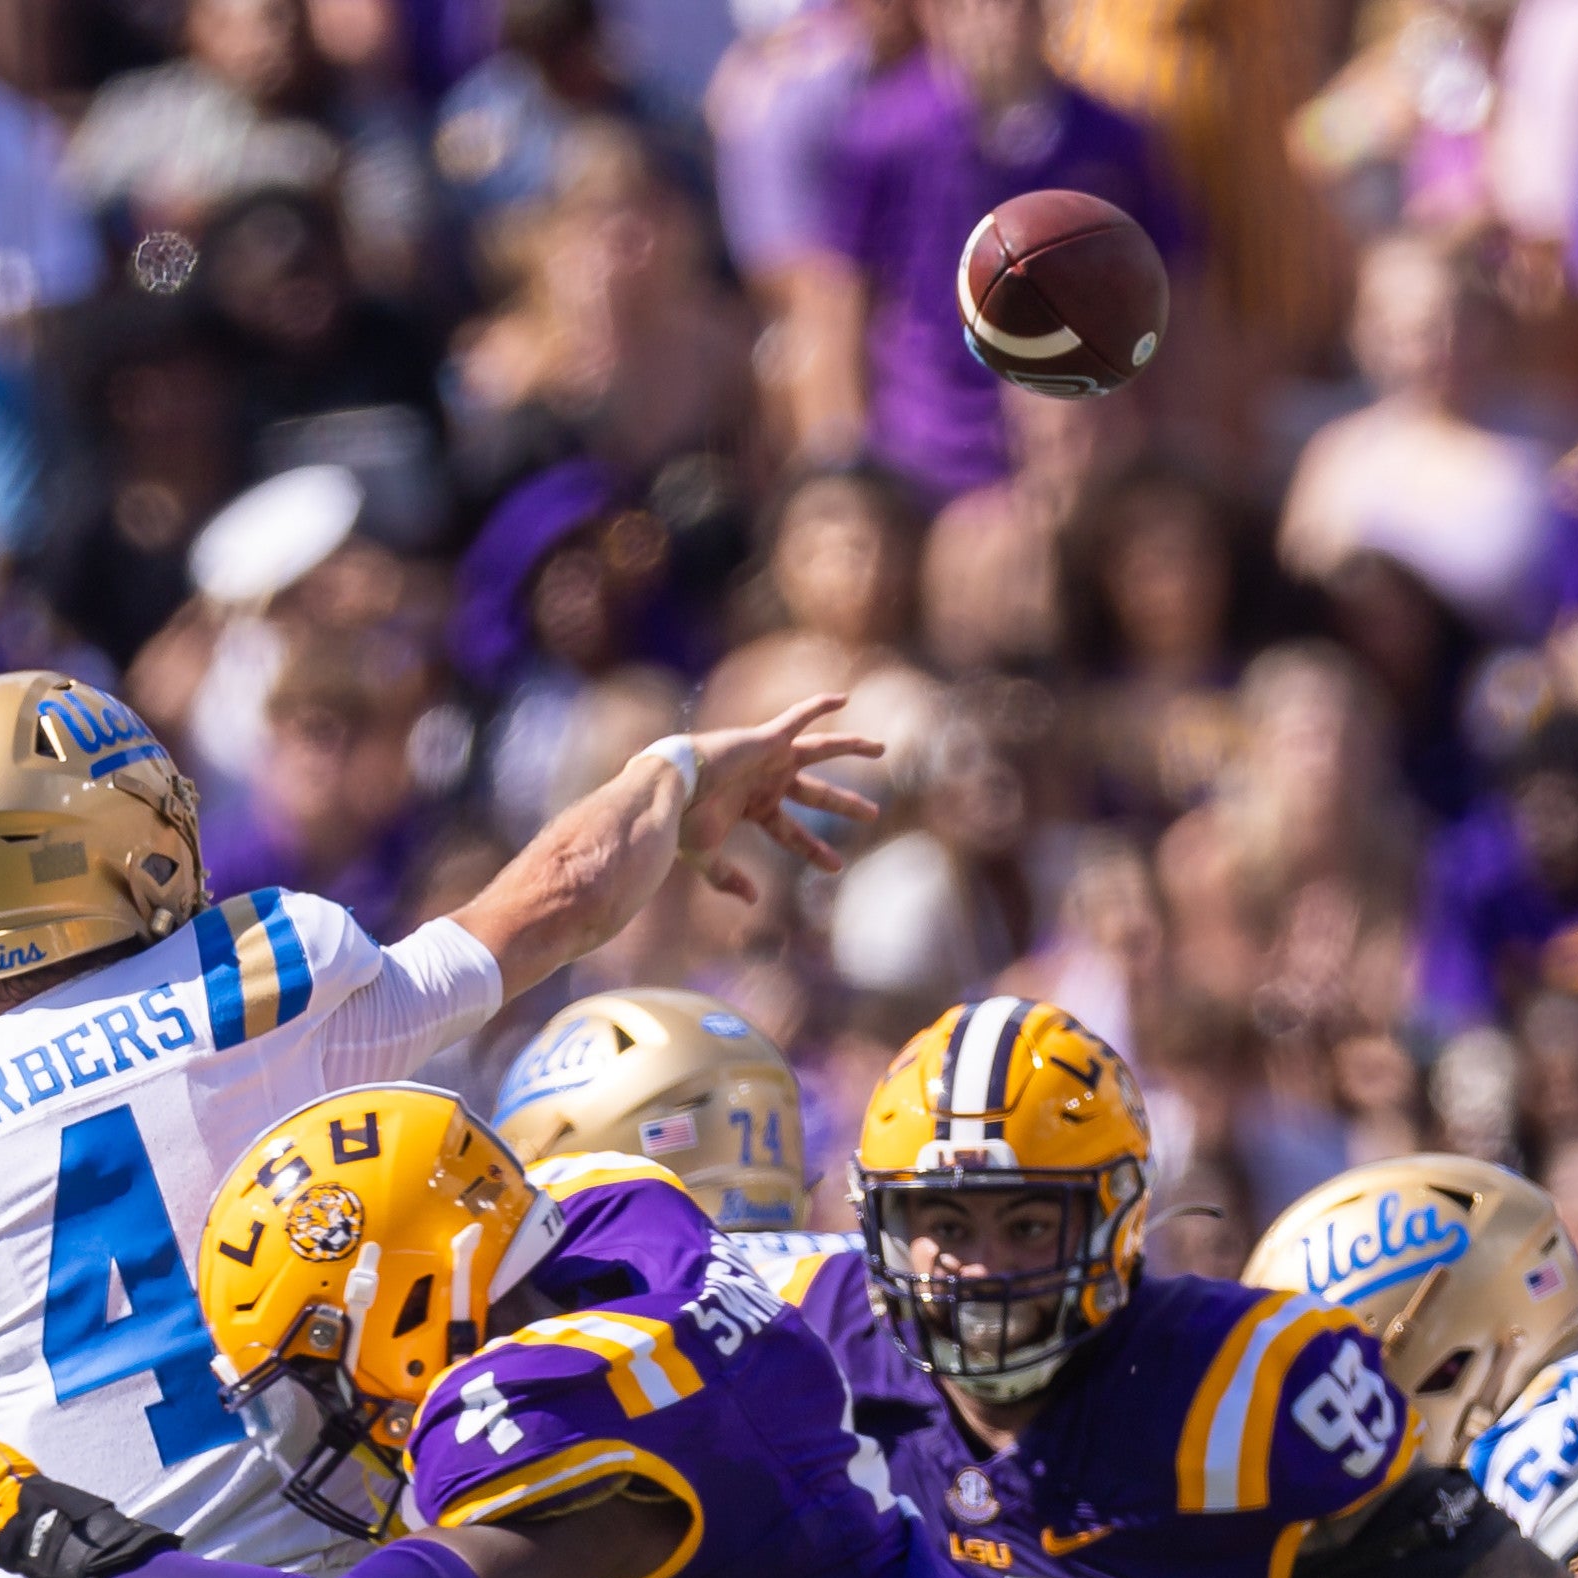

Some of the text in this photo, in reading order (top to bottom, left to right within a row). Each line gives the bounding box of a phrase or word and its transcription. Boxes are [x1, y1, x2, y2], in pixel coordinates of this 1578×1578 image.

[729, 1111, 783, 1167] 74
[219, 1112, 381, 1267] LSU
[44, 1103, 250, 1467] 4
[1300, 1192, 1470, 1306] Ucla
[454, 1371, 524, 1455] 4
[949, 1532, 1014, 1570] LSU
